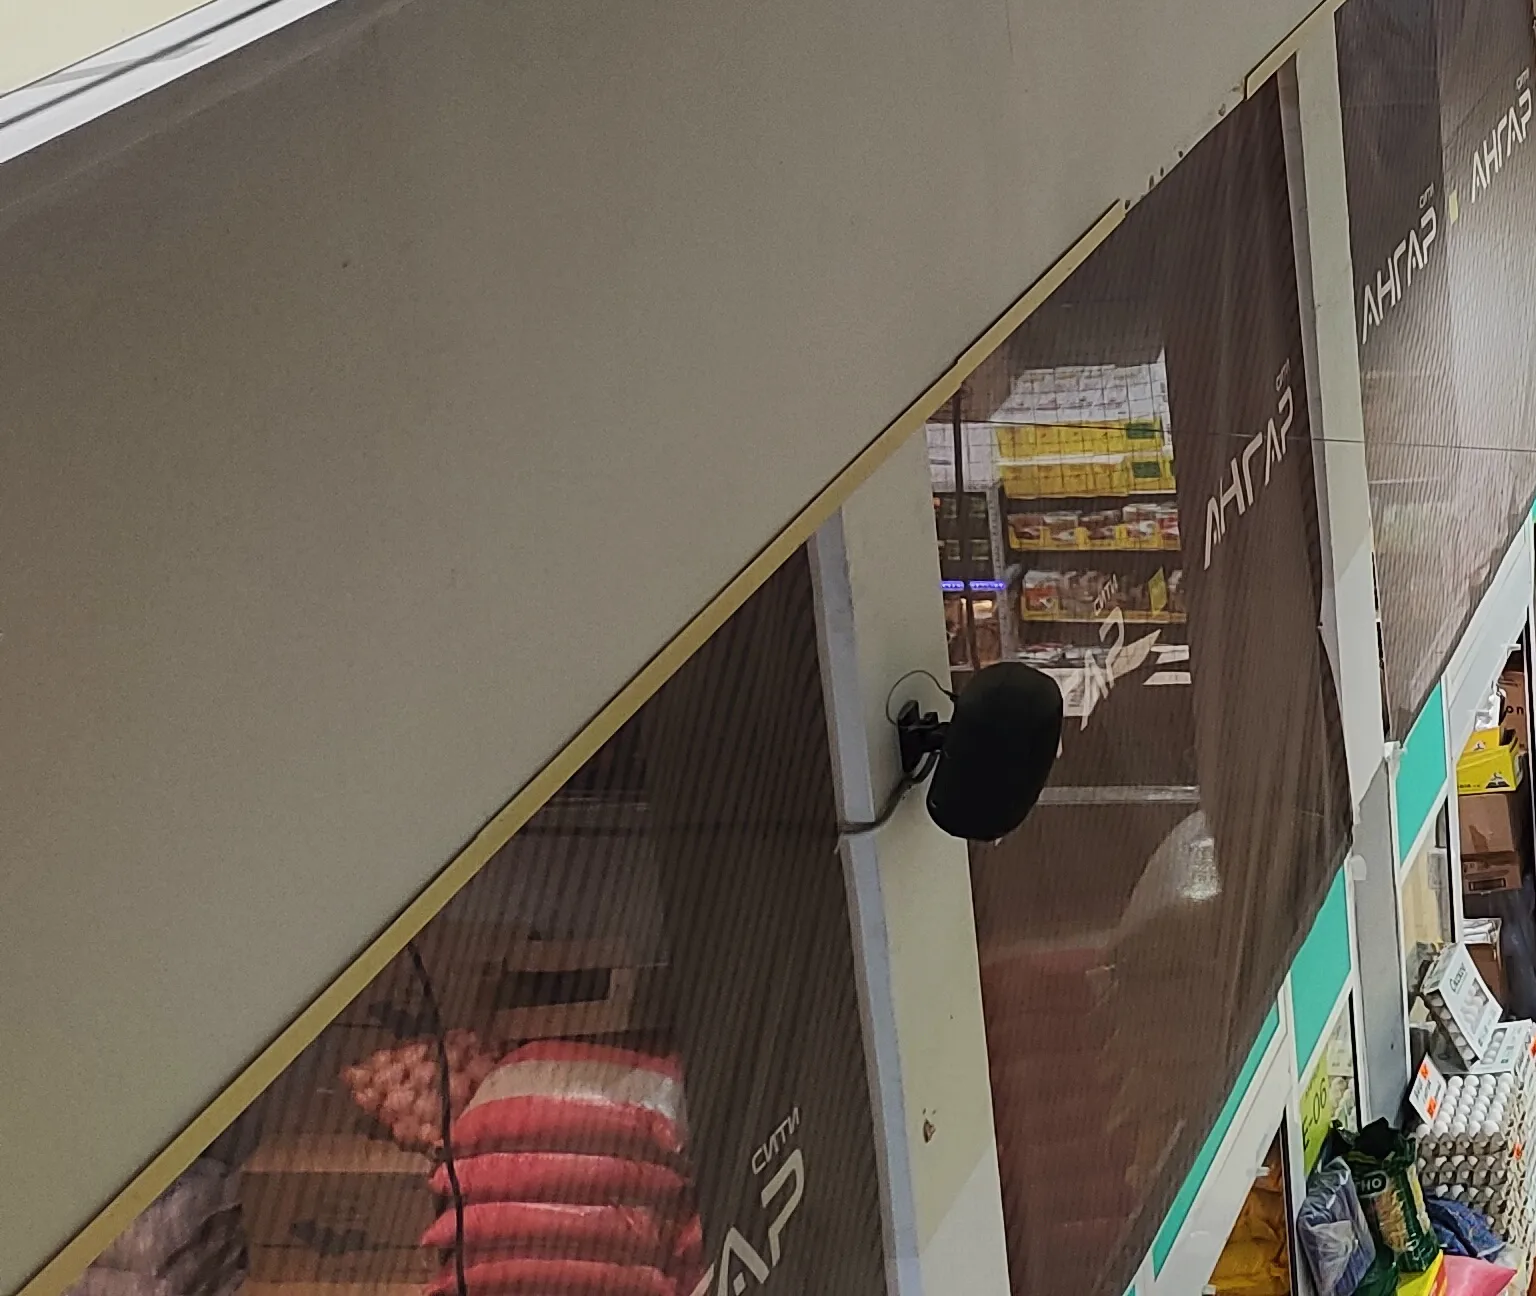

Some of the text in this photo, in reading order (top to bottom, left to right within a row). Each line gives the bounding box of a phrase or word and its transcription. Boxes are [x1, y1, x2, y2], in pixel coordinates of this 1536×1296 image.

[1471, 88, 1532, 203] АНГАР
[1362, 206, 1436, 344] АНГАР
[1204, 386, 1294, 570] АНГАР
